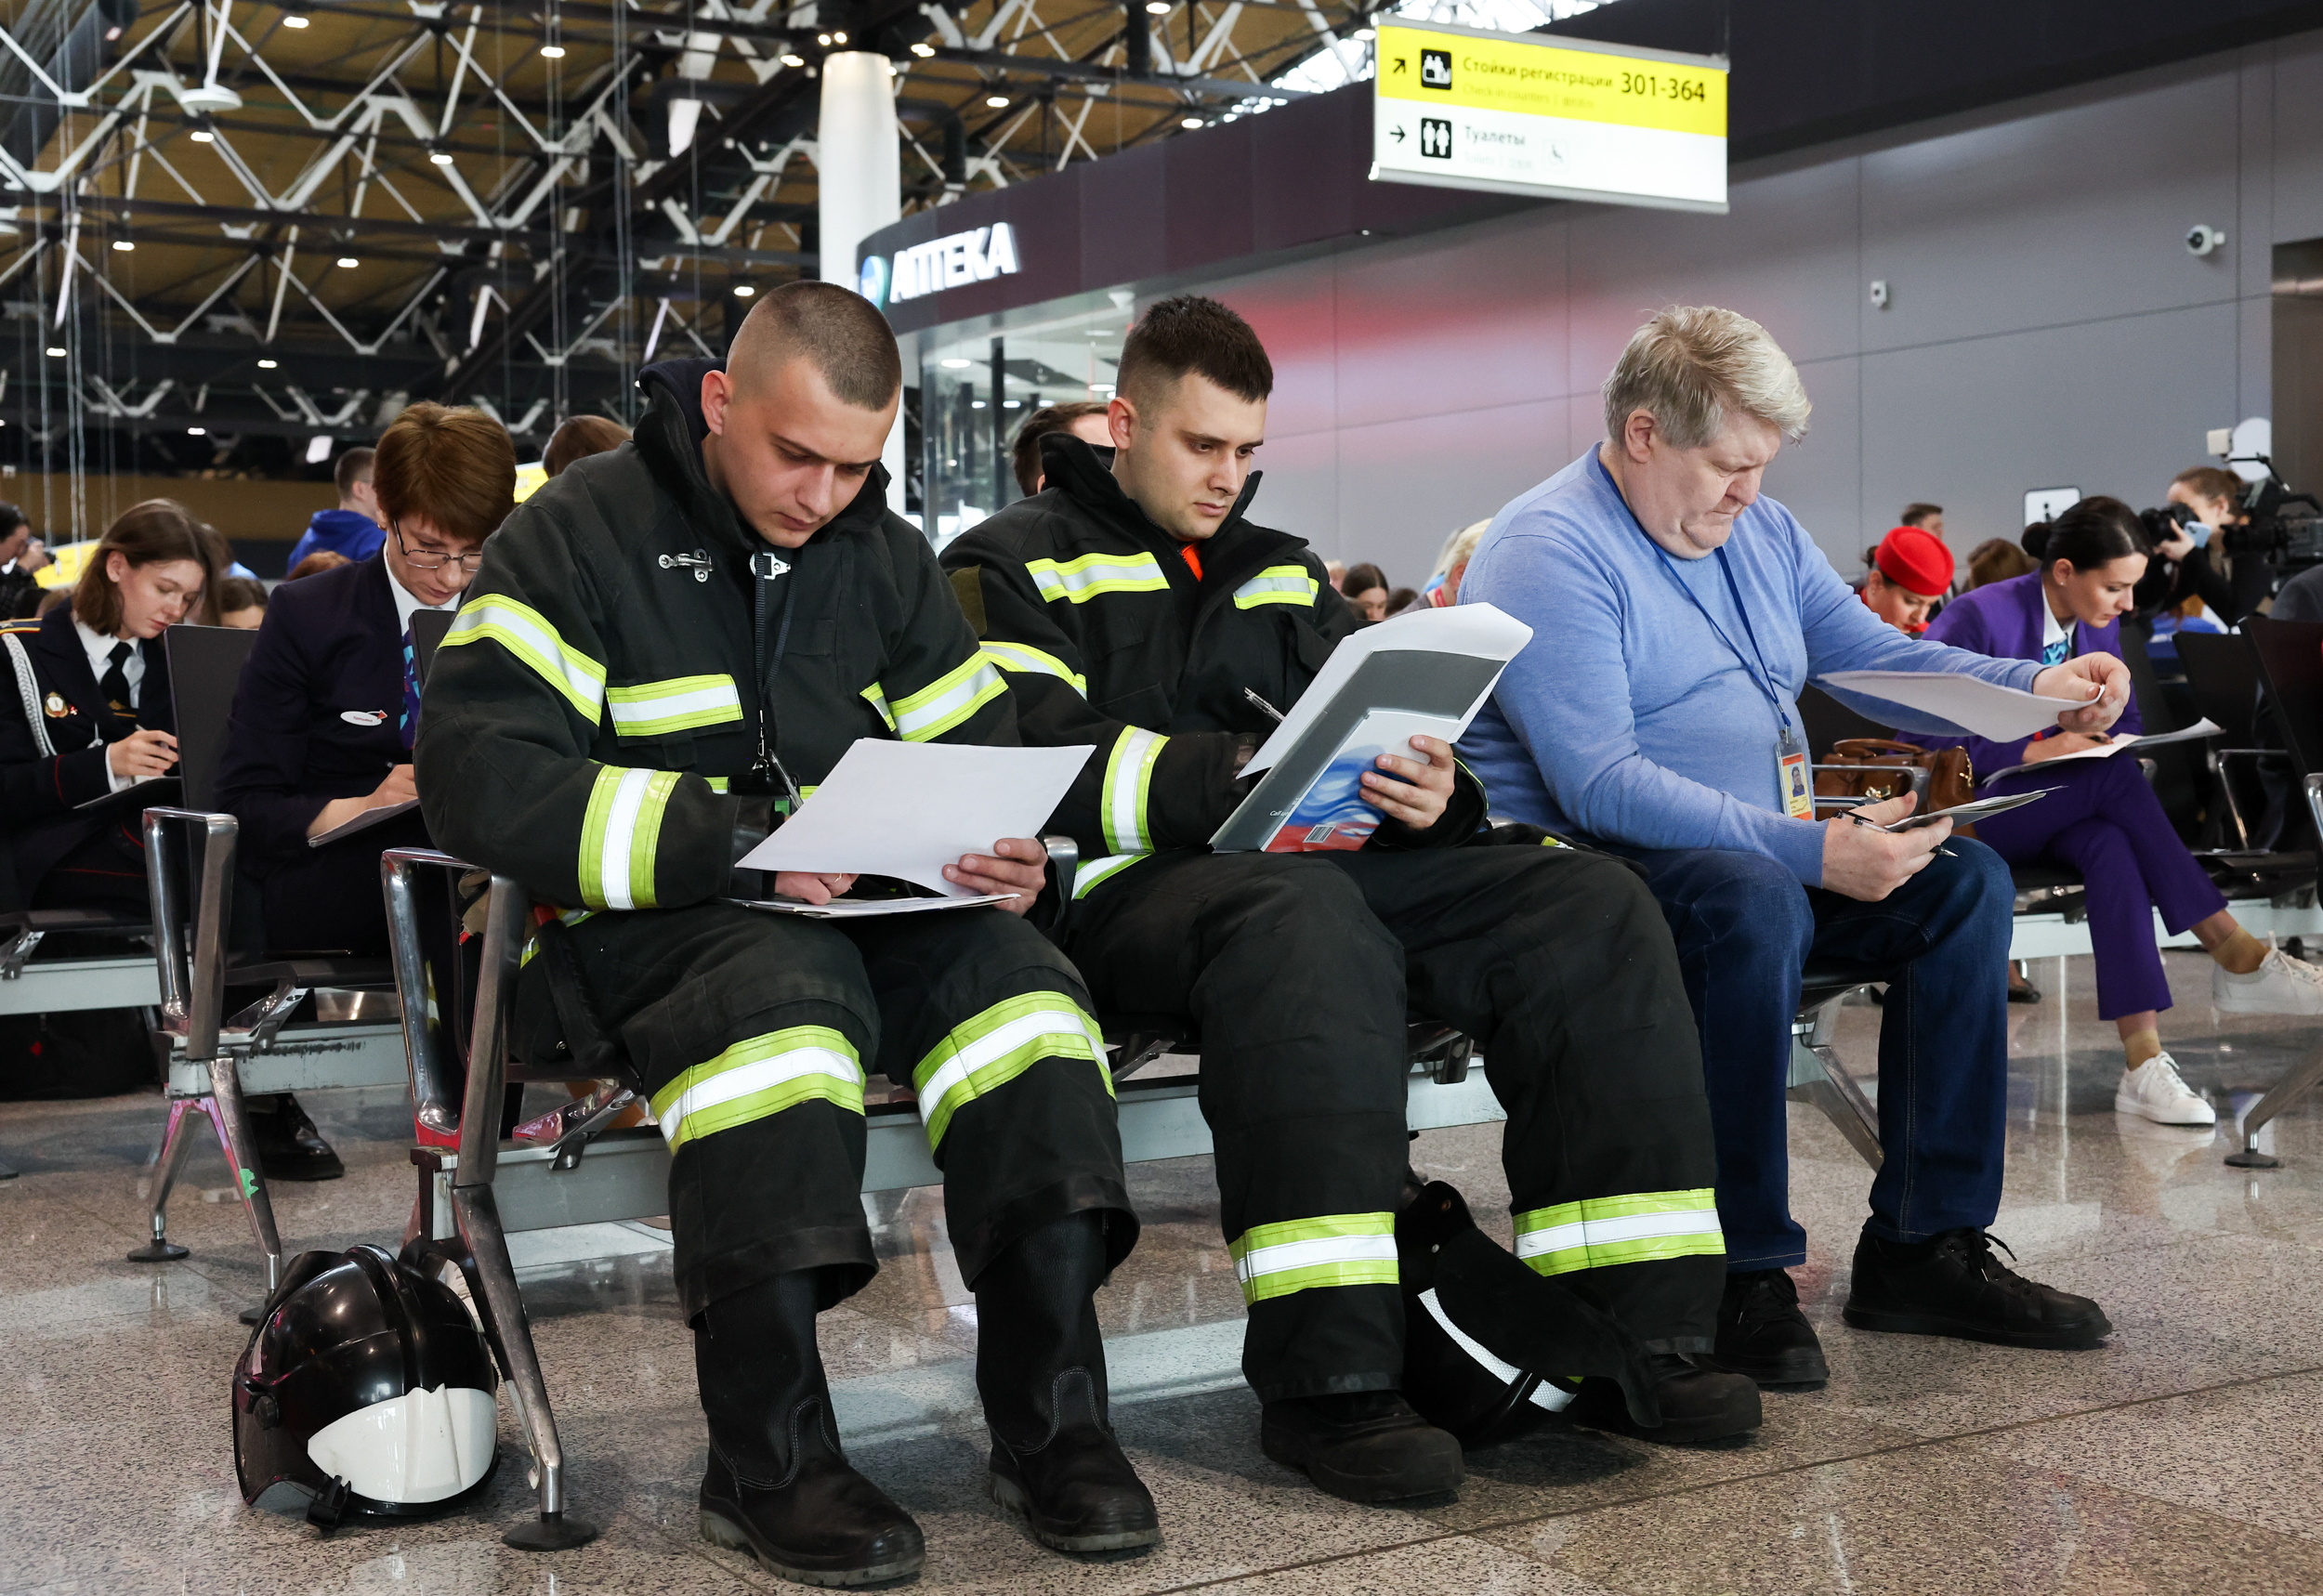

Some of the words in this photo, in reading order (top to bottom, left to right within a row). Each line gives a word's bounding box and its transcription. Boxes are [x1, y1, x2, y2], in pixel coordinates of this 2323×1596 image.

[1463, 57, 1516, 76] Стойки
[1519, 67, 1613, 88] регистрации
[1621, 72, 1705, 102] 301-364
[1464, 125, 1526, 145] Туалеты
[890, 222, 1018, 304] АПТЕКА
